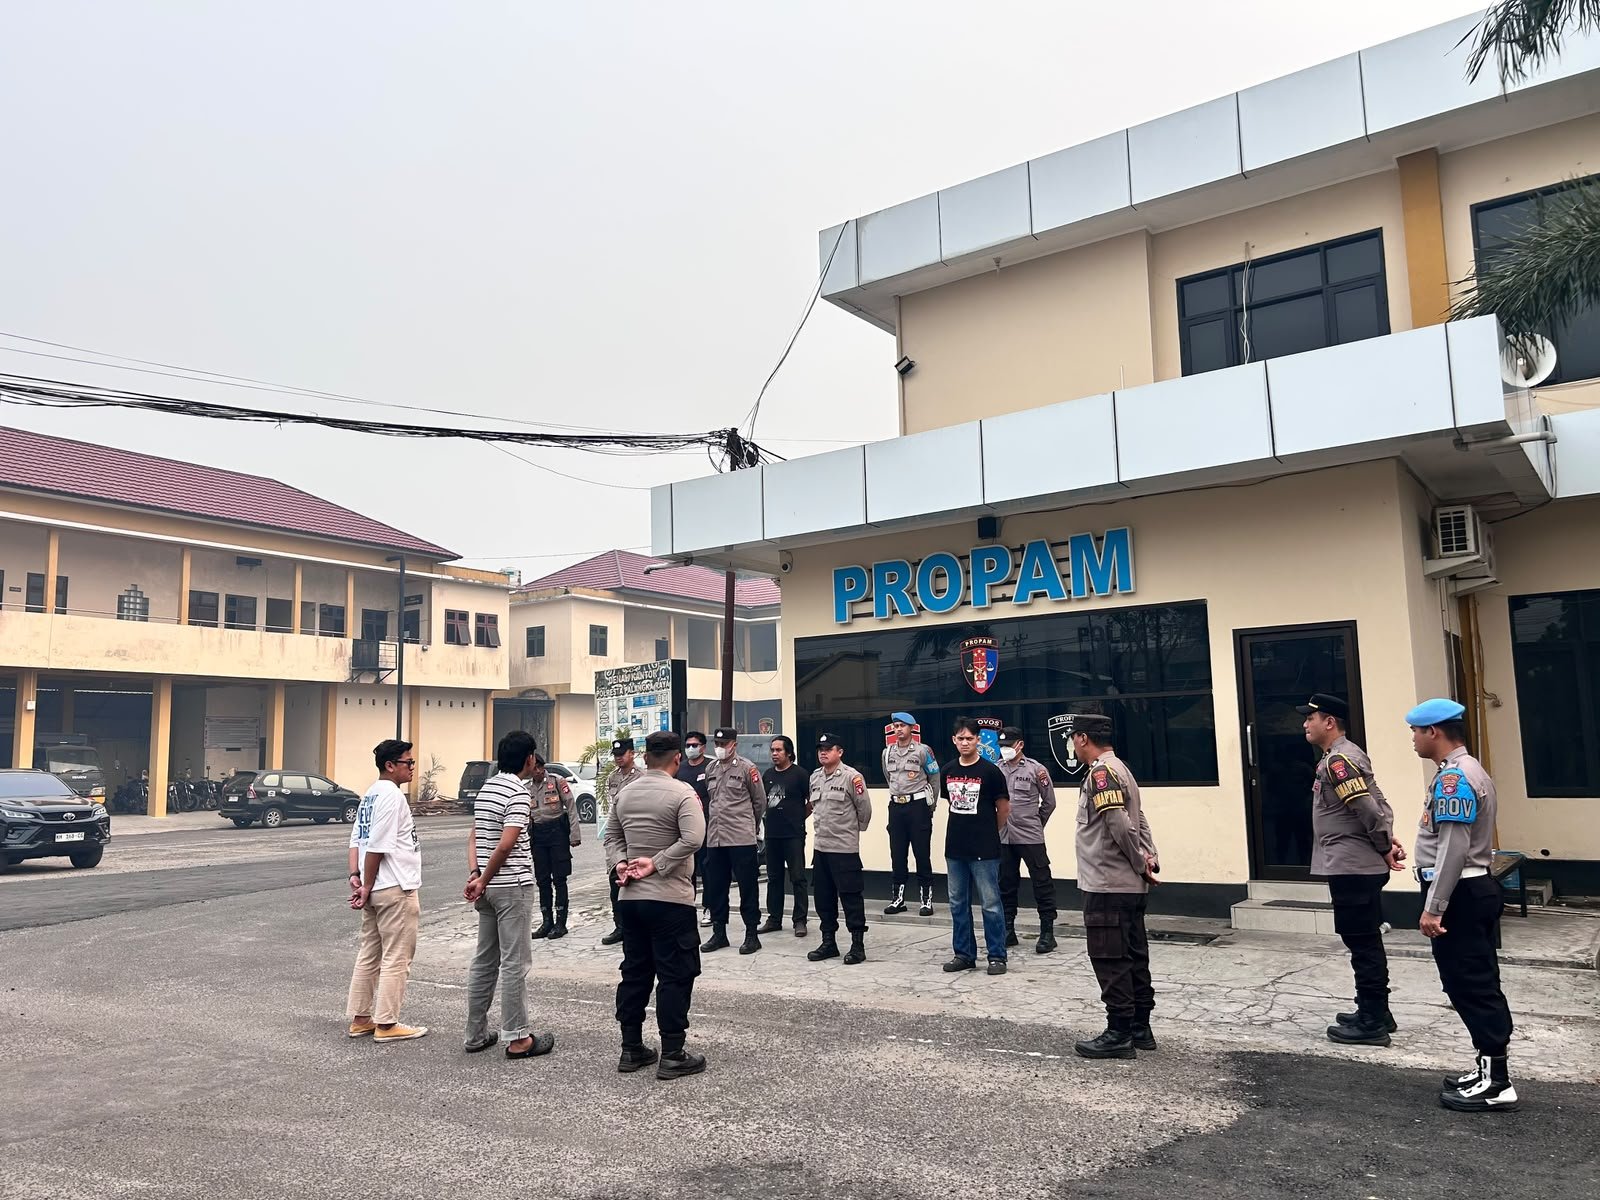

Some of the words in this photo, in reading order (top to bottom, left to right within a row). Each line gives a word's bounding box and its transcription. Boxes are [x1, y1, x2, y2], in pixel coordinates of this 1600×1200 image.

[832, 526, 1137, 624] PROPAM
[965, 638, 992, 647] PROPAM
[977, 719, 1000, 727] OVOS
[1436, 797, 1473, 818] ROV
